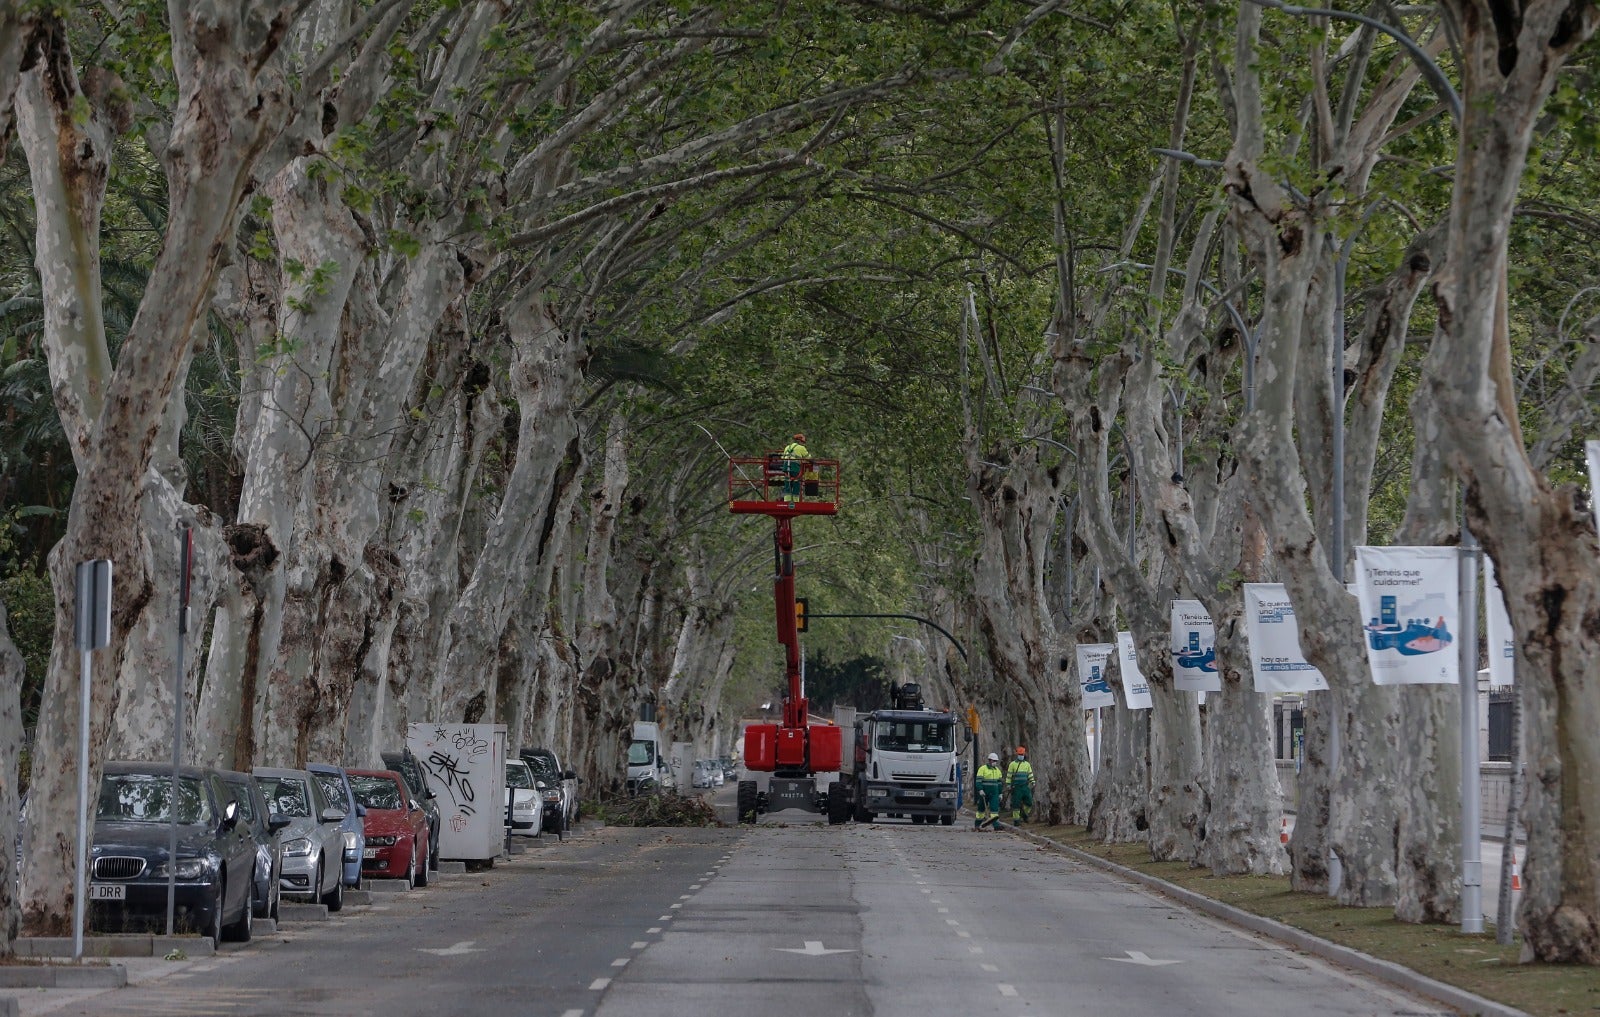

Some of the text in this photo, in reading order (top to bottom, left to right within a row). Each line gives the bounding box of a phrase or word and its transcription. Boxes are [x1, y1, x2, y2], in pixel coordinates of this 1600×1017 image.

[1403, 570, 1420, 578] que
[1261, 656, 1275, 664] hay
[100, 886, 121, 897] DRR
